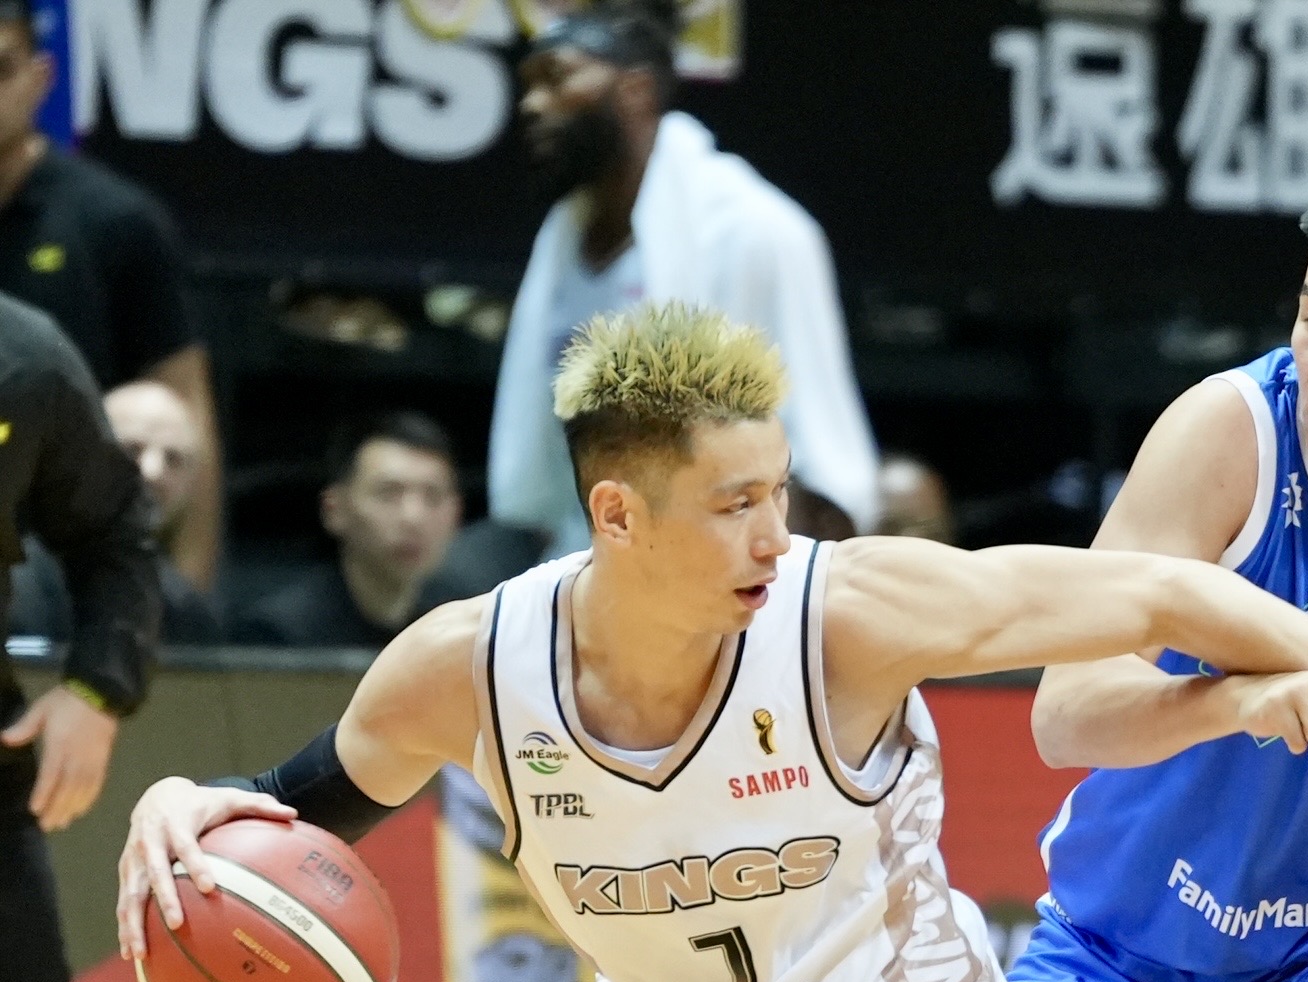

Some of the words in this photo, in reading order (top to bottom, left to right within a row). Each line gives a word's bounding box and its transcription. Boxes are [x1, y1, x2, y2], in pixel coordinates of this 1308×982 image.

[515, 749, 535, 760] JM
[537, 748, 569, 761] Eagle
[728, 765, 810, 799] SAMPO
[529, 793, 595, 819] TPBL
[554, 836, 841, 914] KINGS
